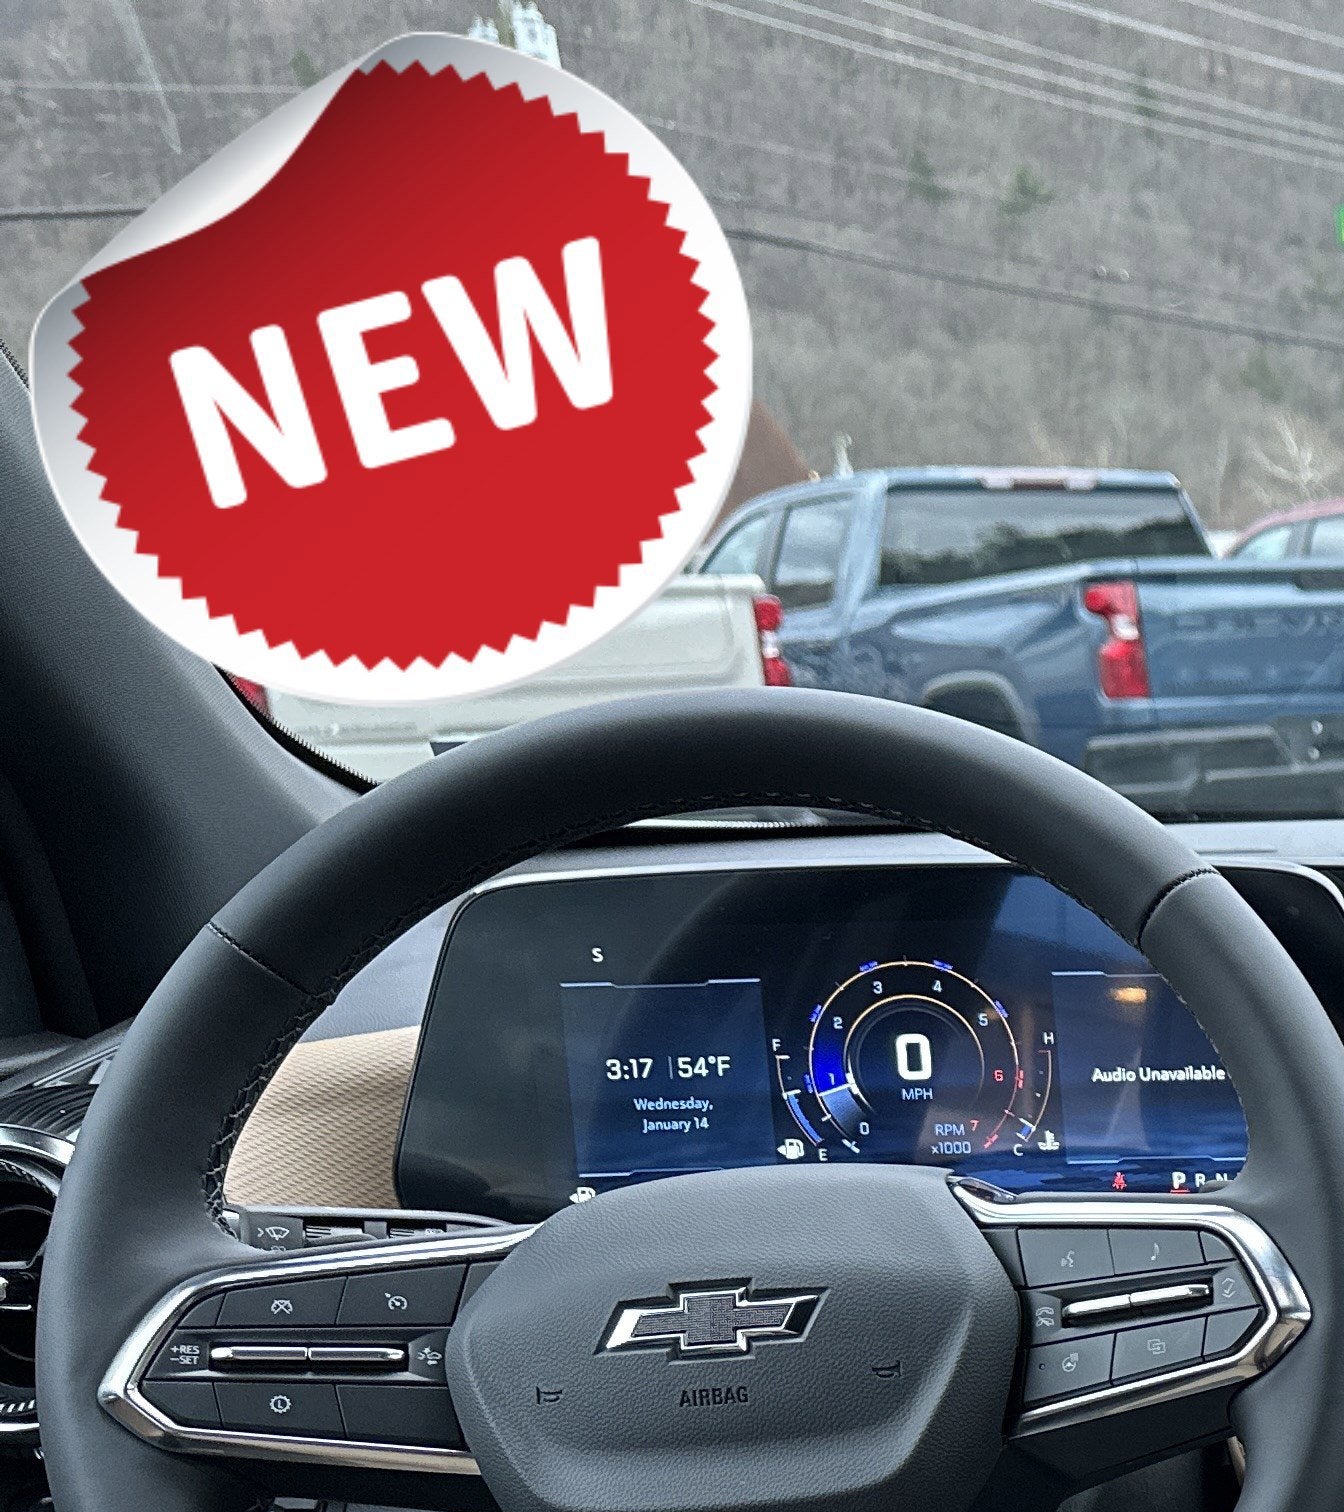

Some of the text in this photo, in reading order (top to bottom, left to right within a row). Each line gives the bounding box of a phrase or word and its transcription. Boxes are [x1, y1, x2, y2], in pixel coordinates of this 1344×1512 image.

[591, 948, 604, 963] S
[873, 981, 883, 995] 3
[932, 981, 943, 993] 4
[833, 1016, 843, 1029] 2
[978, 1013, 989, 1027] 5
[1043, 1032, 1054, 1045] H
[772, 1039, 781, 1052] F
[895, 1033, 932, 1080] 0
[605, 1055, 731, 1080] 3:17 54°F
[1091, 1065, 1226, 1083] Audio Unavailable
[828, 1073, 835, 1085] 1
[994, 1069, 1004, 1082] 6
[901, 1088, 933, 1101] MPH
[633, 1097, 714, 1113] Wednesday,
[642, 1117, 709, 1134] January 14
[859, 1122, 870, 1135] 0
[935, 1124, 966, 1136] RPM
[970, 1119, 979, 1131] 7
[930, 1141, 972, 1155] x1000
[1013, 1143, 1023, 1156] C
[819, 1149, 828, 1162] E
[1172, 1171, 1186, 1189] P
[1195, 1173, 1206, 1187] R
[679, 1387, 749, 1408] AIRBAG
